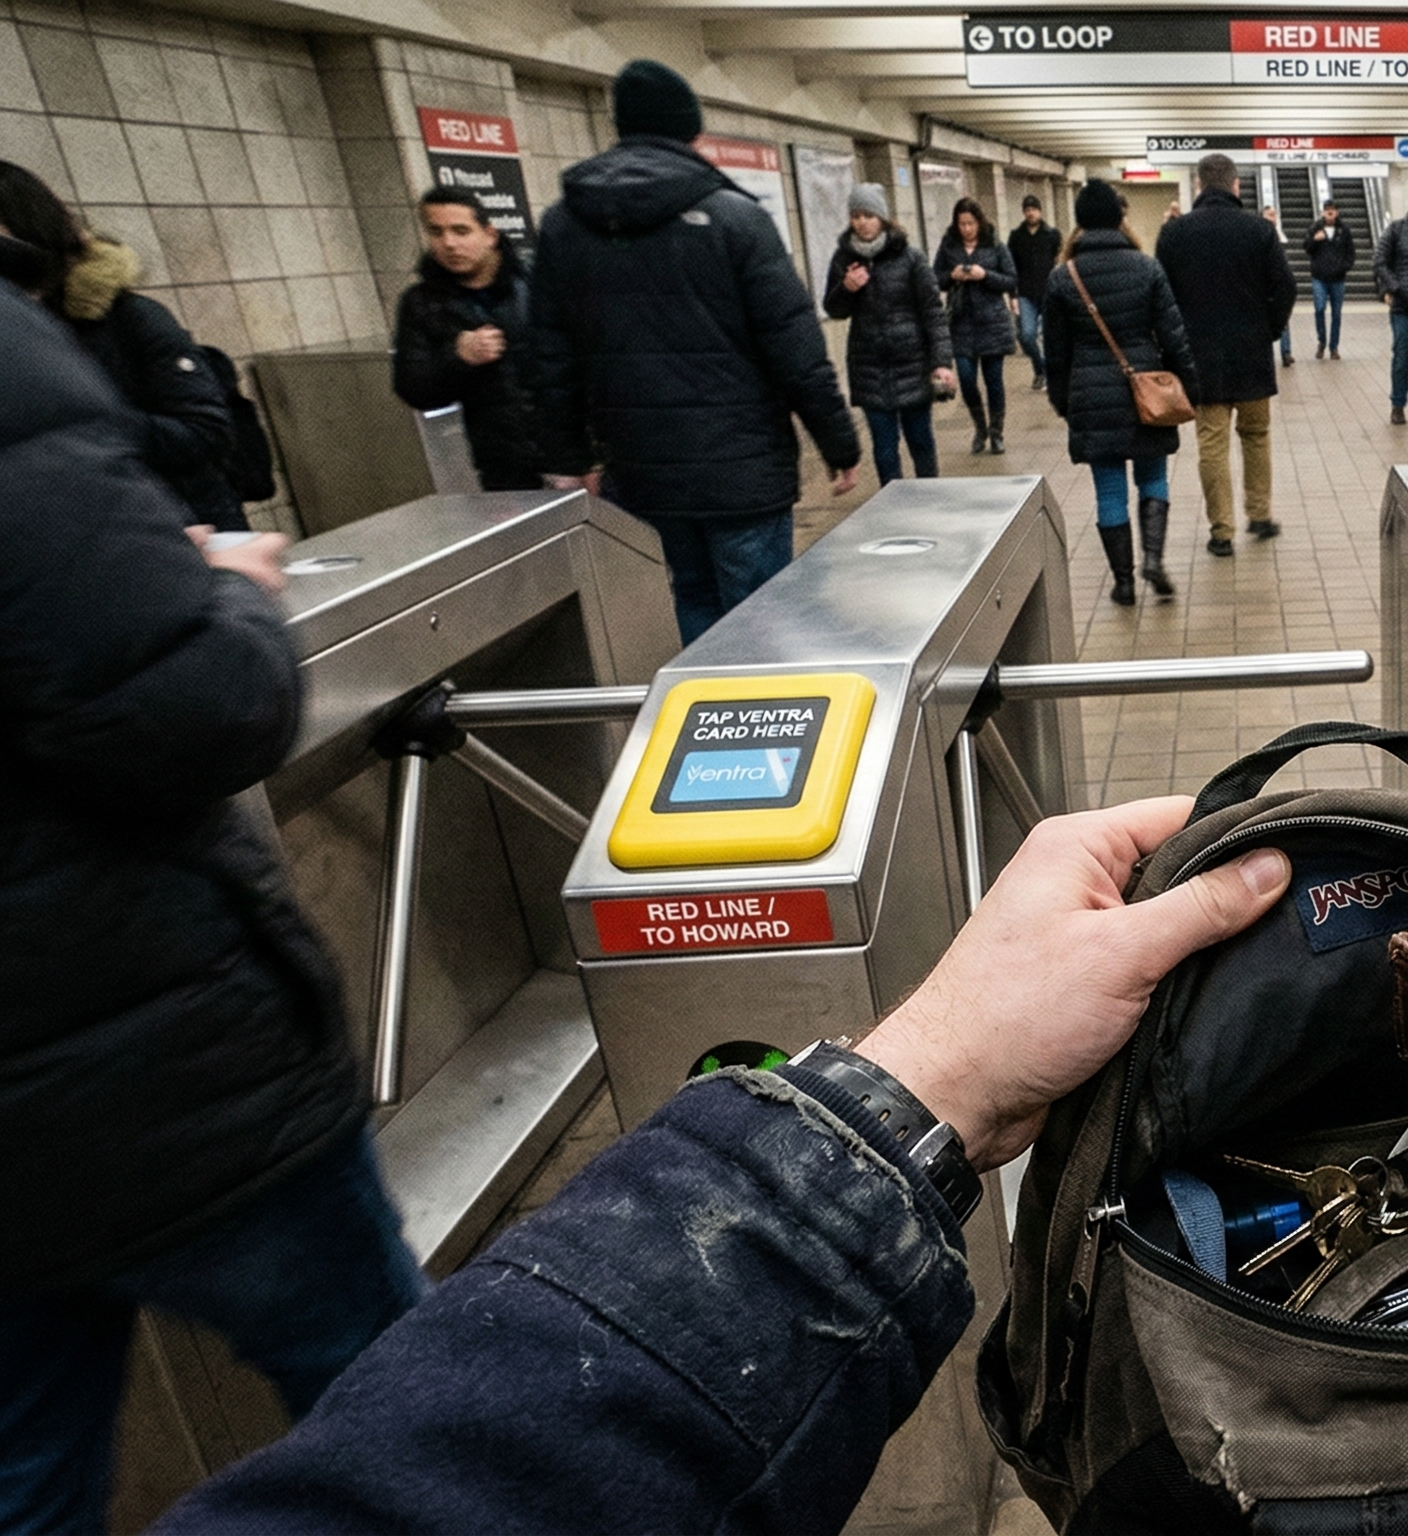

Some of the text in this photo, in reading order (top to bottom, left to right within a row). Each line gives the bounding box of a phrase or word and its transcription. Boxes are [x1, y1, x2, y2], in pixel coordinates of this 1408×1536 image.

[998, 26, 1113, 48] TO LOOP
[1264, 26, 1380, 48] RED LINE
[1266, 60, 1309, 77] RED
[1316, 60, 1361, 77] LINE
[1367, 60, 1375, 78] /
[1382, 60, 1408, 77] TO
[437, 118, 505, 146] RED LINE
[1177, 138, 1207, 149] LOOP
[1266, 138, 1314, 149] RED LINE
[697, 708, 814, 725] TAP VENTRA
[693, 723, 807, 740] CARD HERE
[686, 764, 767, 786] Ventra
[646, 896, 775, 921] RED LINE /
[640, 920, 790, 945] TO HOWARD
